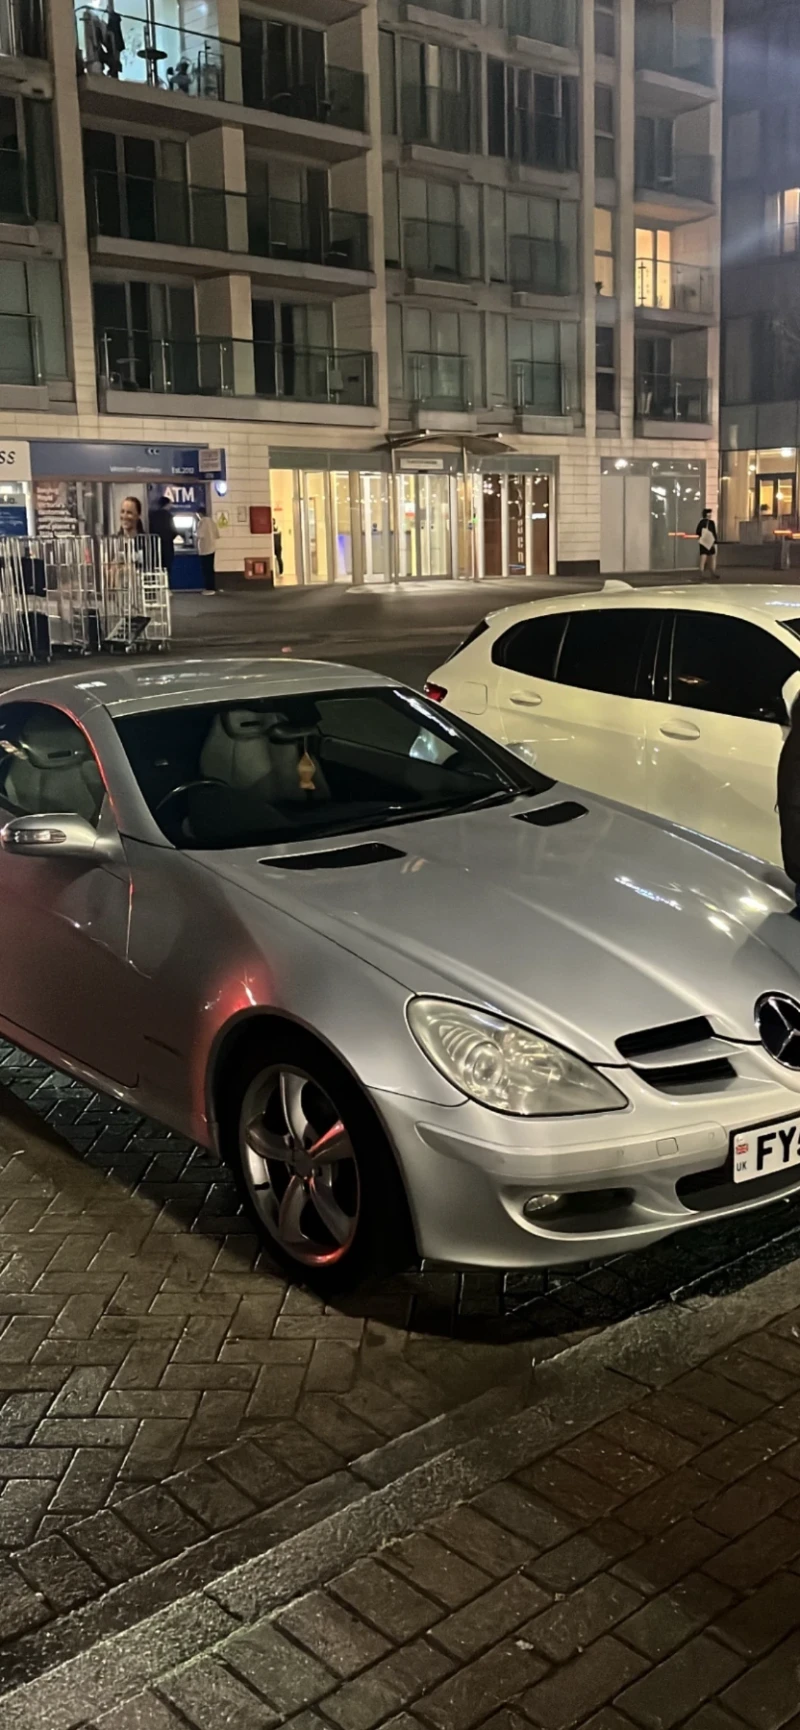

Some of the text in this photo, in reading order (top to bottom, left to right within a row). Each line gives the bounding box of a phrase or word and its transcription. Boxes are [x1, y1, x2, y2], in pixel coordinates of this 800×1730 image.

[163, 486, 195, 503] ATM
[756, 1126, 800, 1171] FY
[736, 1161, 747, 1171] UK
